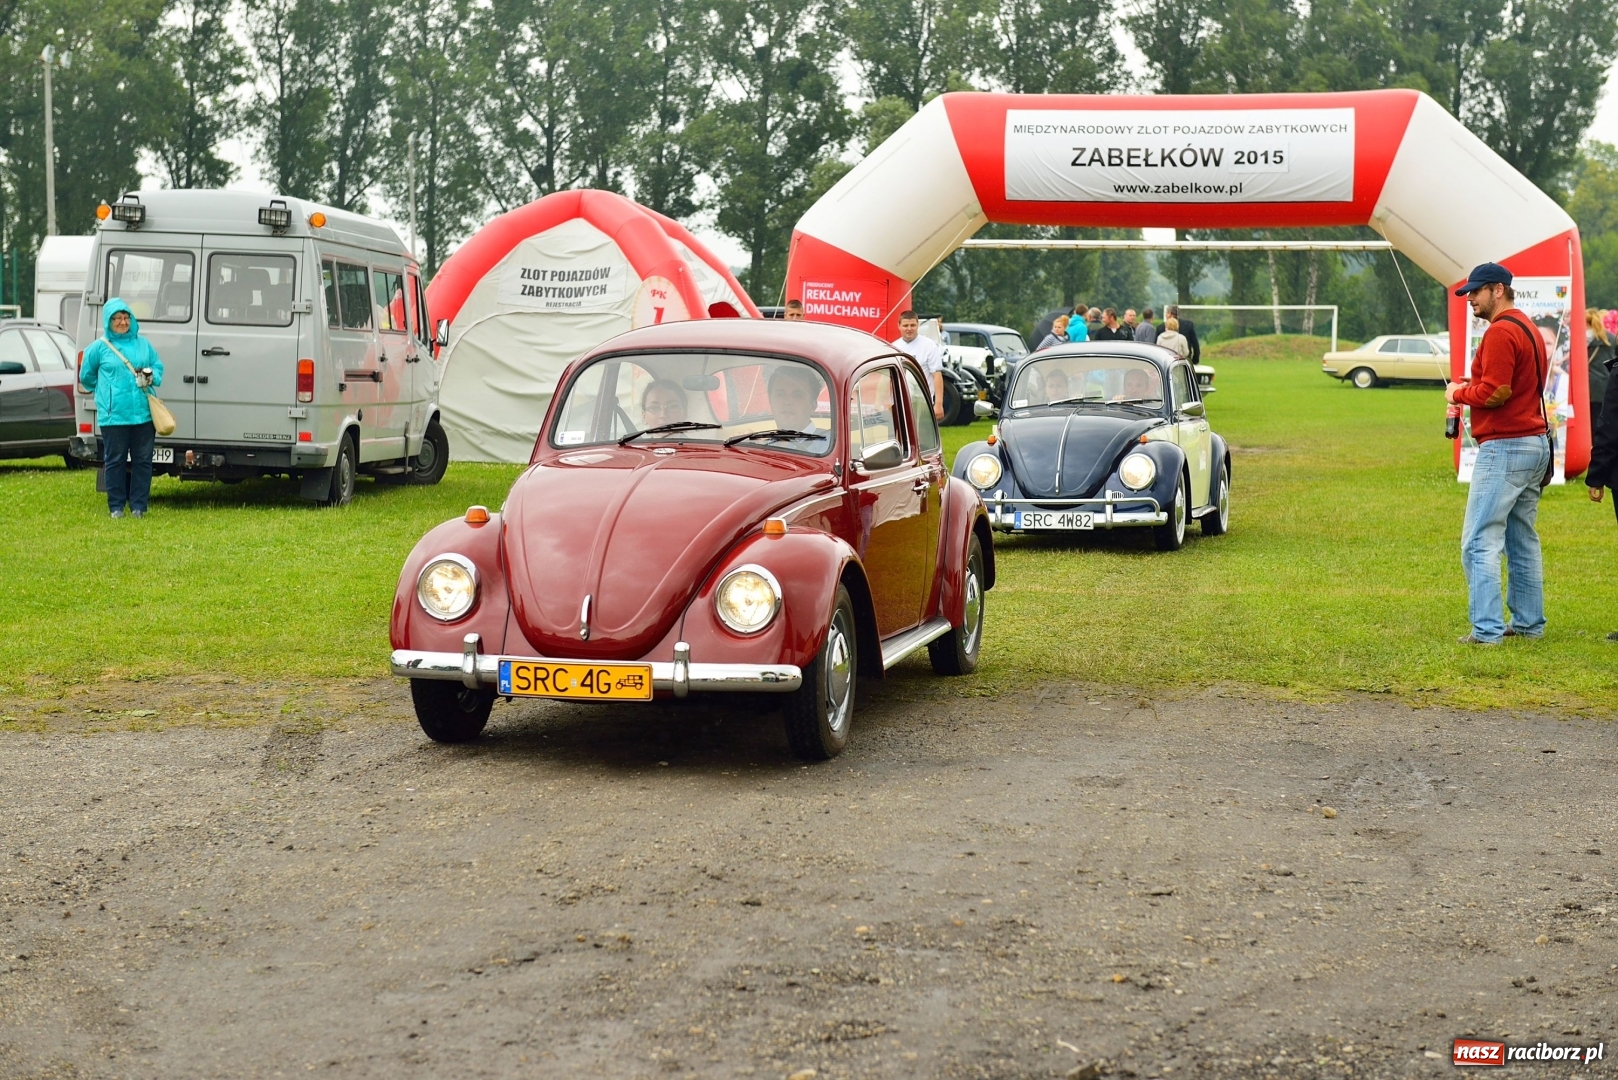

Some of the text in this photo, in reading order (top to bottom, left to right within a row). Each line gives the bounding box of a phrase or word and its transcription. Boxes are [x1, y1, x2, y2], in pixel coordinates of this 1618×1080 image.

[1013, 123, 1348, 136] MIĘDZYNARODOWY ZLOT POJAZDÓW ZABYTKOWYCH
[1070, 143, 1284, 168] ZABEŁKÓW 2015
[1113, 182, 1243, 196] www.zabelkow.pl
[520, 266, 611, 282] ZLOT POJAZDÓW
[520, 284, 607, 299] ZABYTKOWYCH
[806, 289, 862, 303] REKLAMY
[805, 303, 881, 319] DMUCHANEJ
[152, 449, 172, 462] 2H9
[1023, 513, 1053, 527] SRC
[1058, 513, 1092, 528] 4W82
[501, 665, 611, 694] PL SRC 4G
